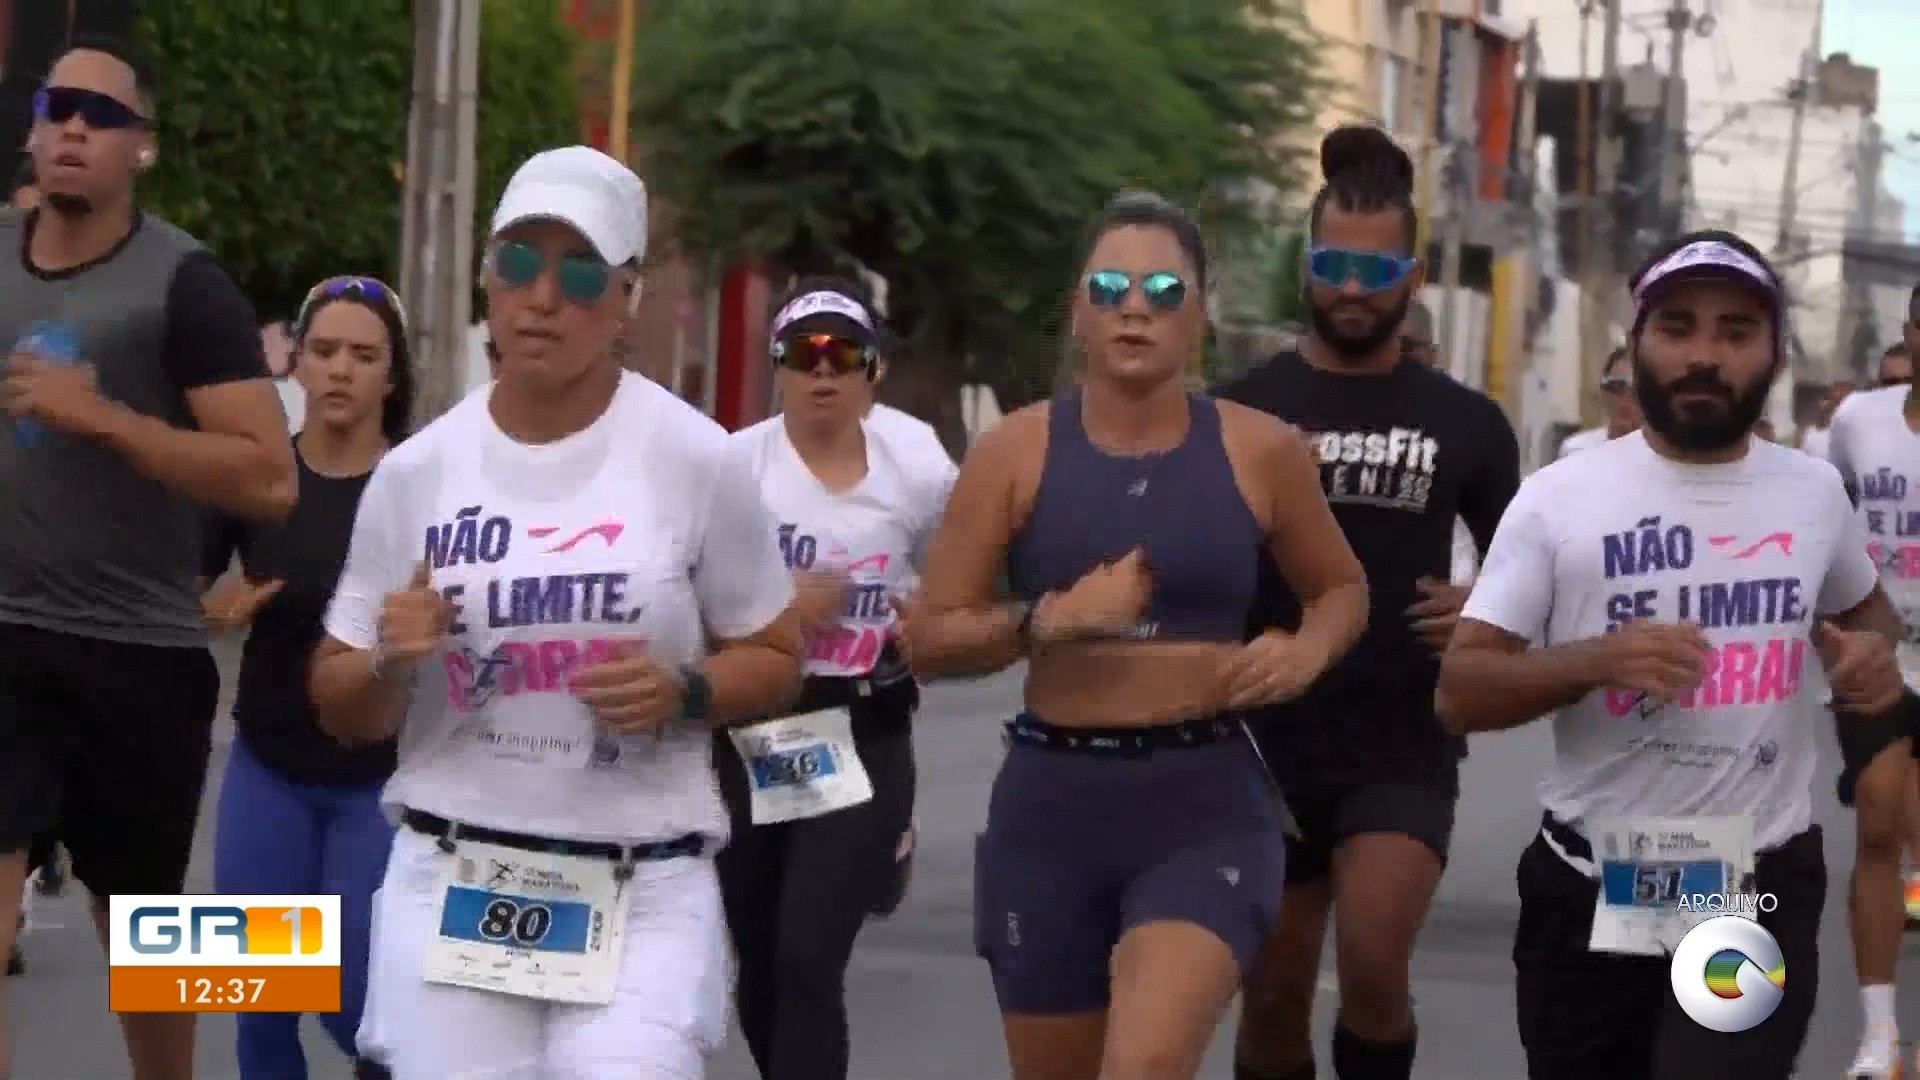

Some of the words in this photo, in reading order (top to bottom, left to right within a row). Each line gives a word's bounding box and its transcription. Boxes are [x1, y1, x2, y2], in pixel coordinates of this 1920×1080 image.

[424, 505, 513, 569] NÃO
[1602, 516, 1694, 578] NÃO
[441, 584, 468, 633] E
[487, 573, 642, 629] LIMITE,
[1678, 577, 1807, 628] LIMITE,
[479, 900, 552, 944] 80
